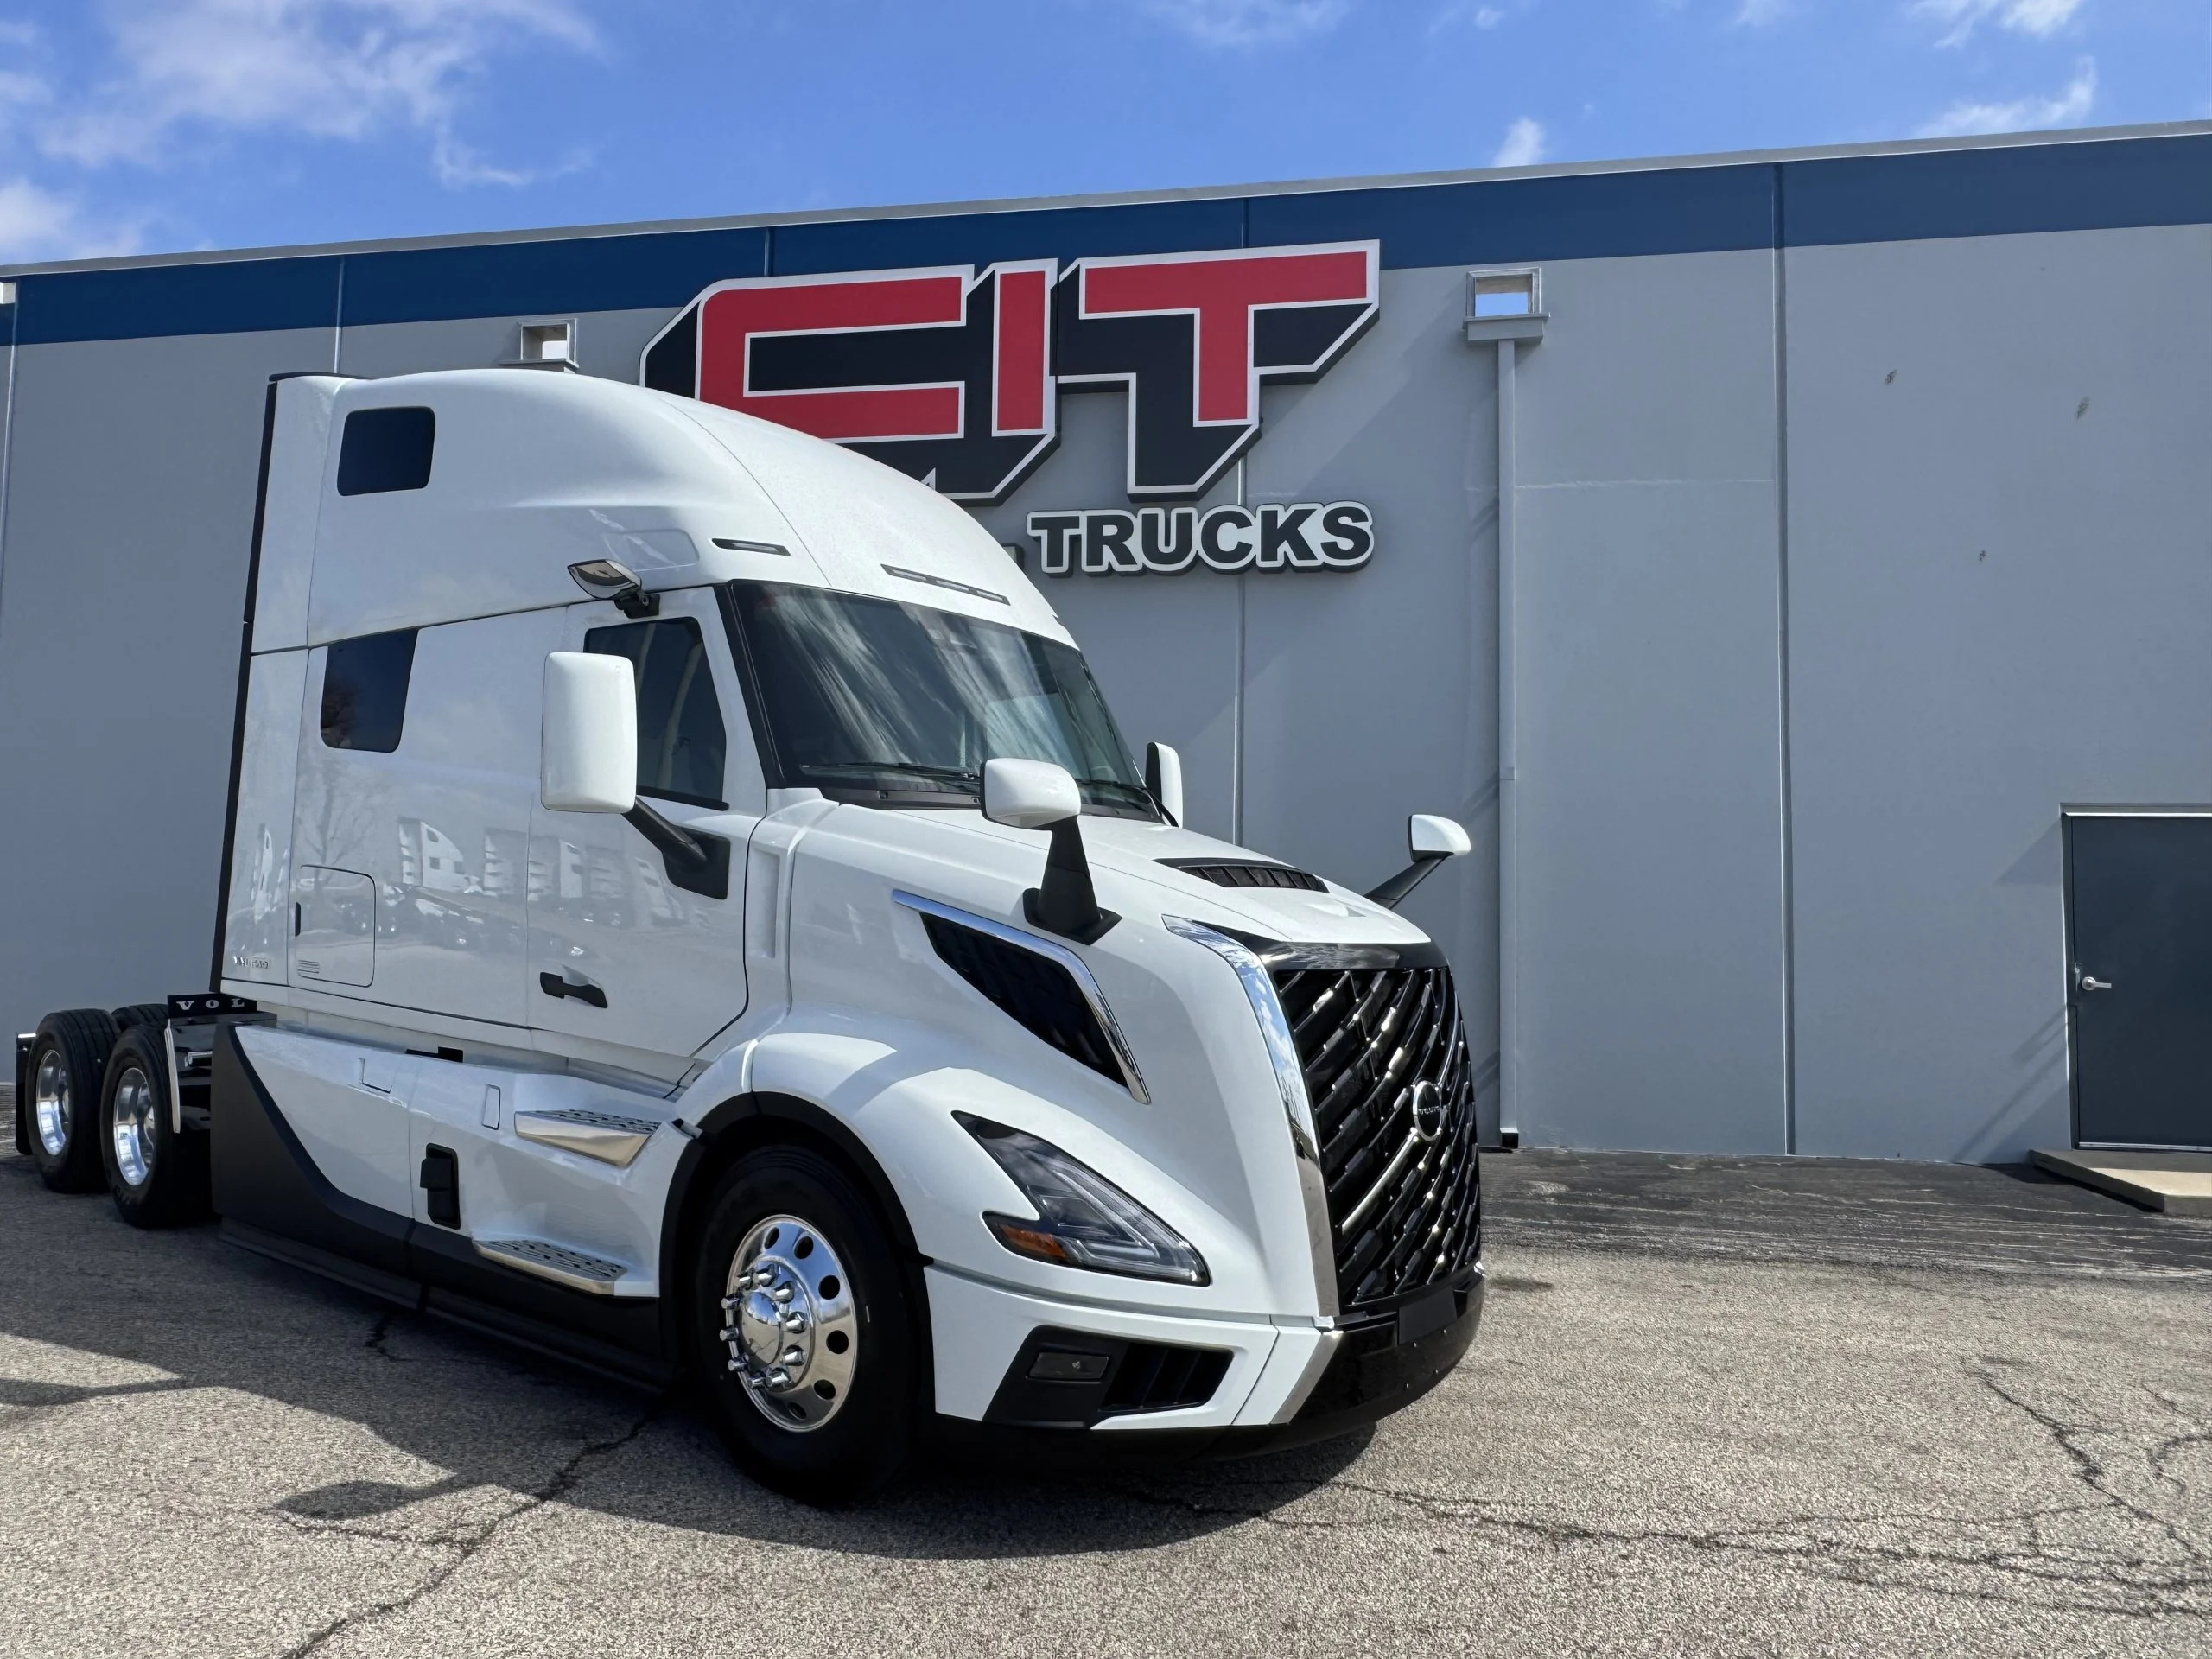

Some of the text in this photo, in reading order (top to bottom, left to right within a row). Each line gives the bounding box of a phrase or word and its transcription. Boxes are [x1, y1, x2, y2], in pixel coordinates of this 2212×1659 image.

[687, 239, 1381, 449] CIT
[1027, 501, 1376, 573] TRUCKS
[175, 998, 245, 1011] VOL
